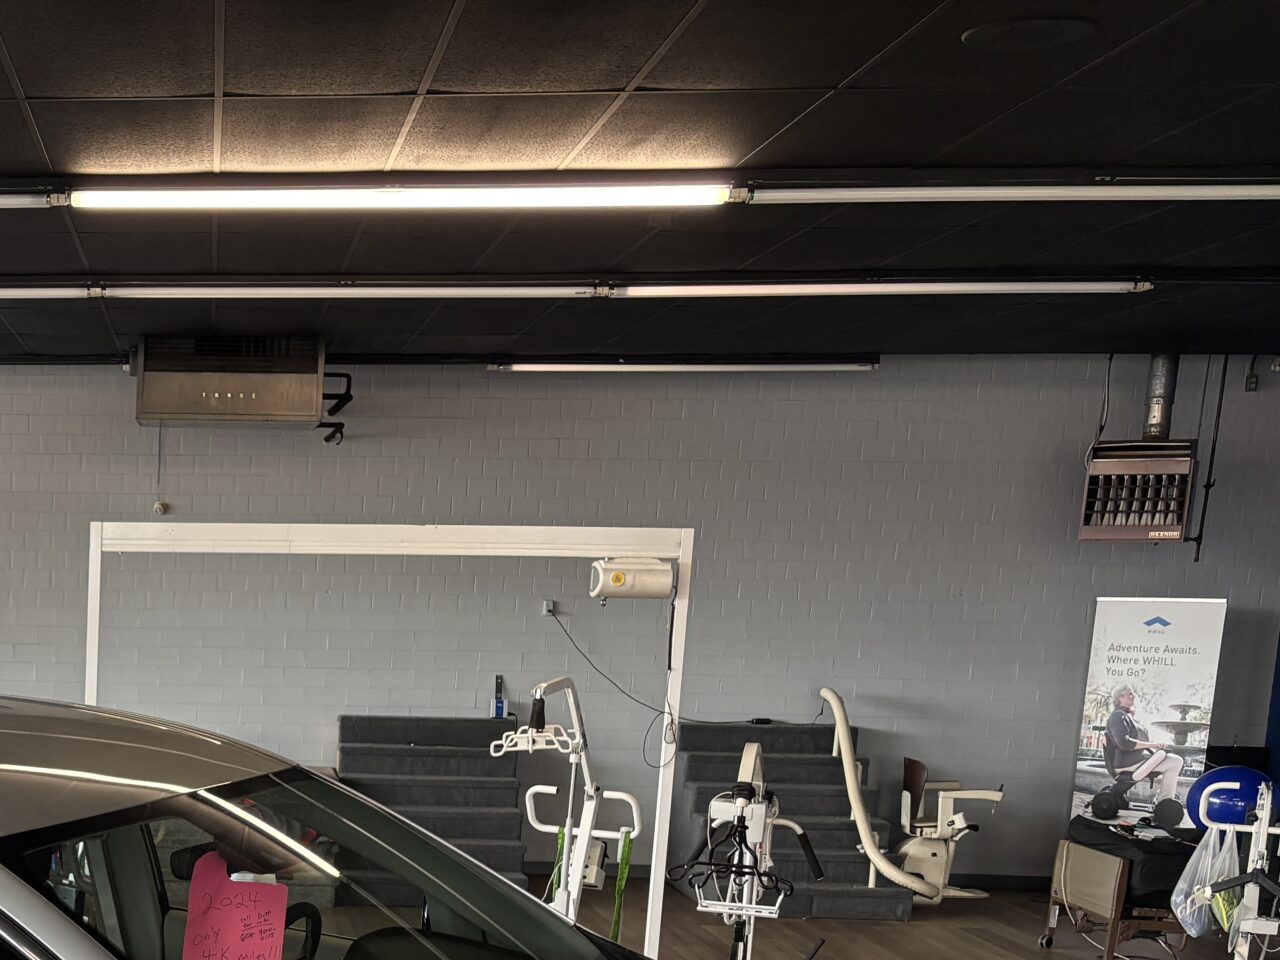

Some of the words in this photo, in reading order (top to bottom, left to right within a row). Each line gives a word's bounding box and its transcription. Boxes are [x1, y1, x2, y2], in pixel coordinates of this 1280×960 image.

[1108, 643, 1160, 653] Adventure
[1162, 645, 1201, 655] Awaits.
[1107, 655, 1140, 665] Where
[1142, 656, 1177, 667] WHILL
[1105, 666, 1124, 677] You
[1126, 667, 1146, 677] Go?
[202, 891, 261, 916] 2024
